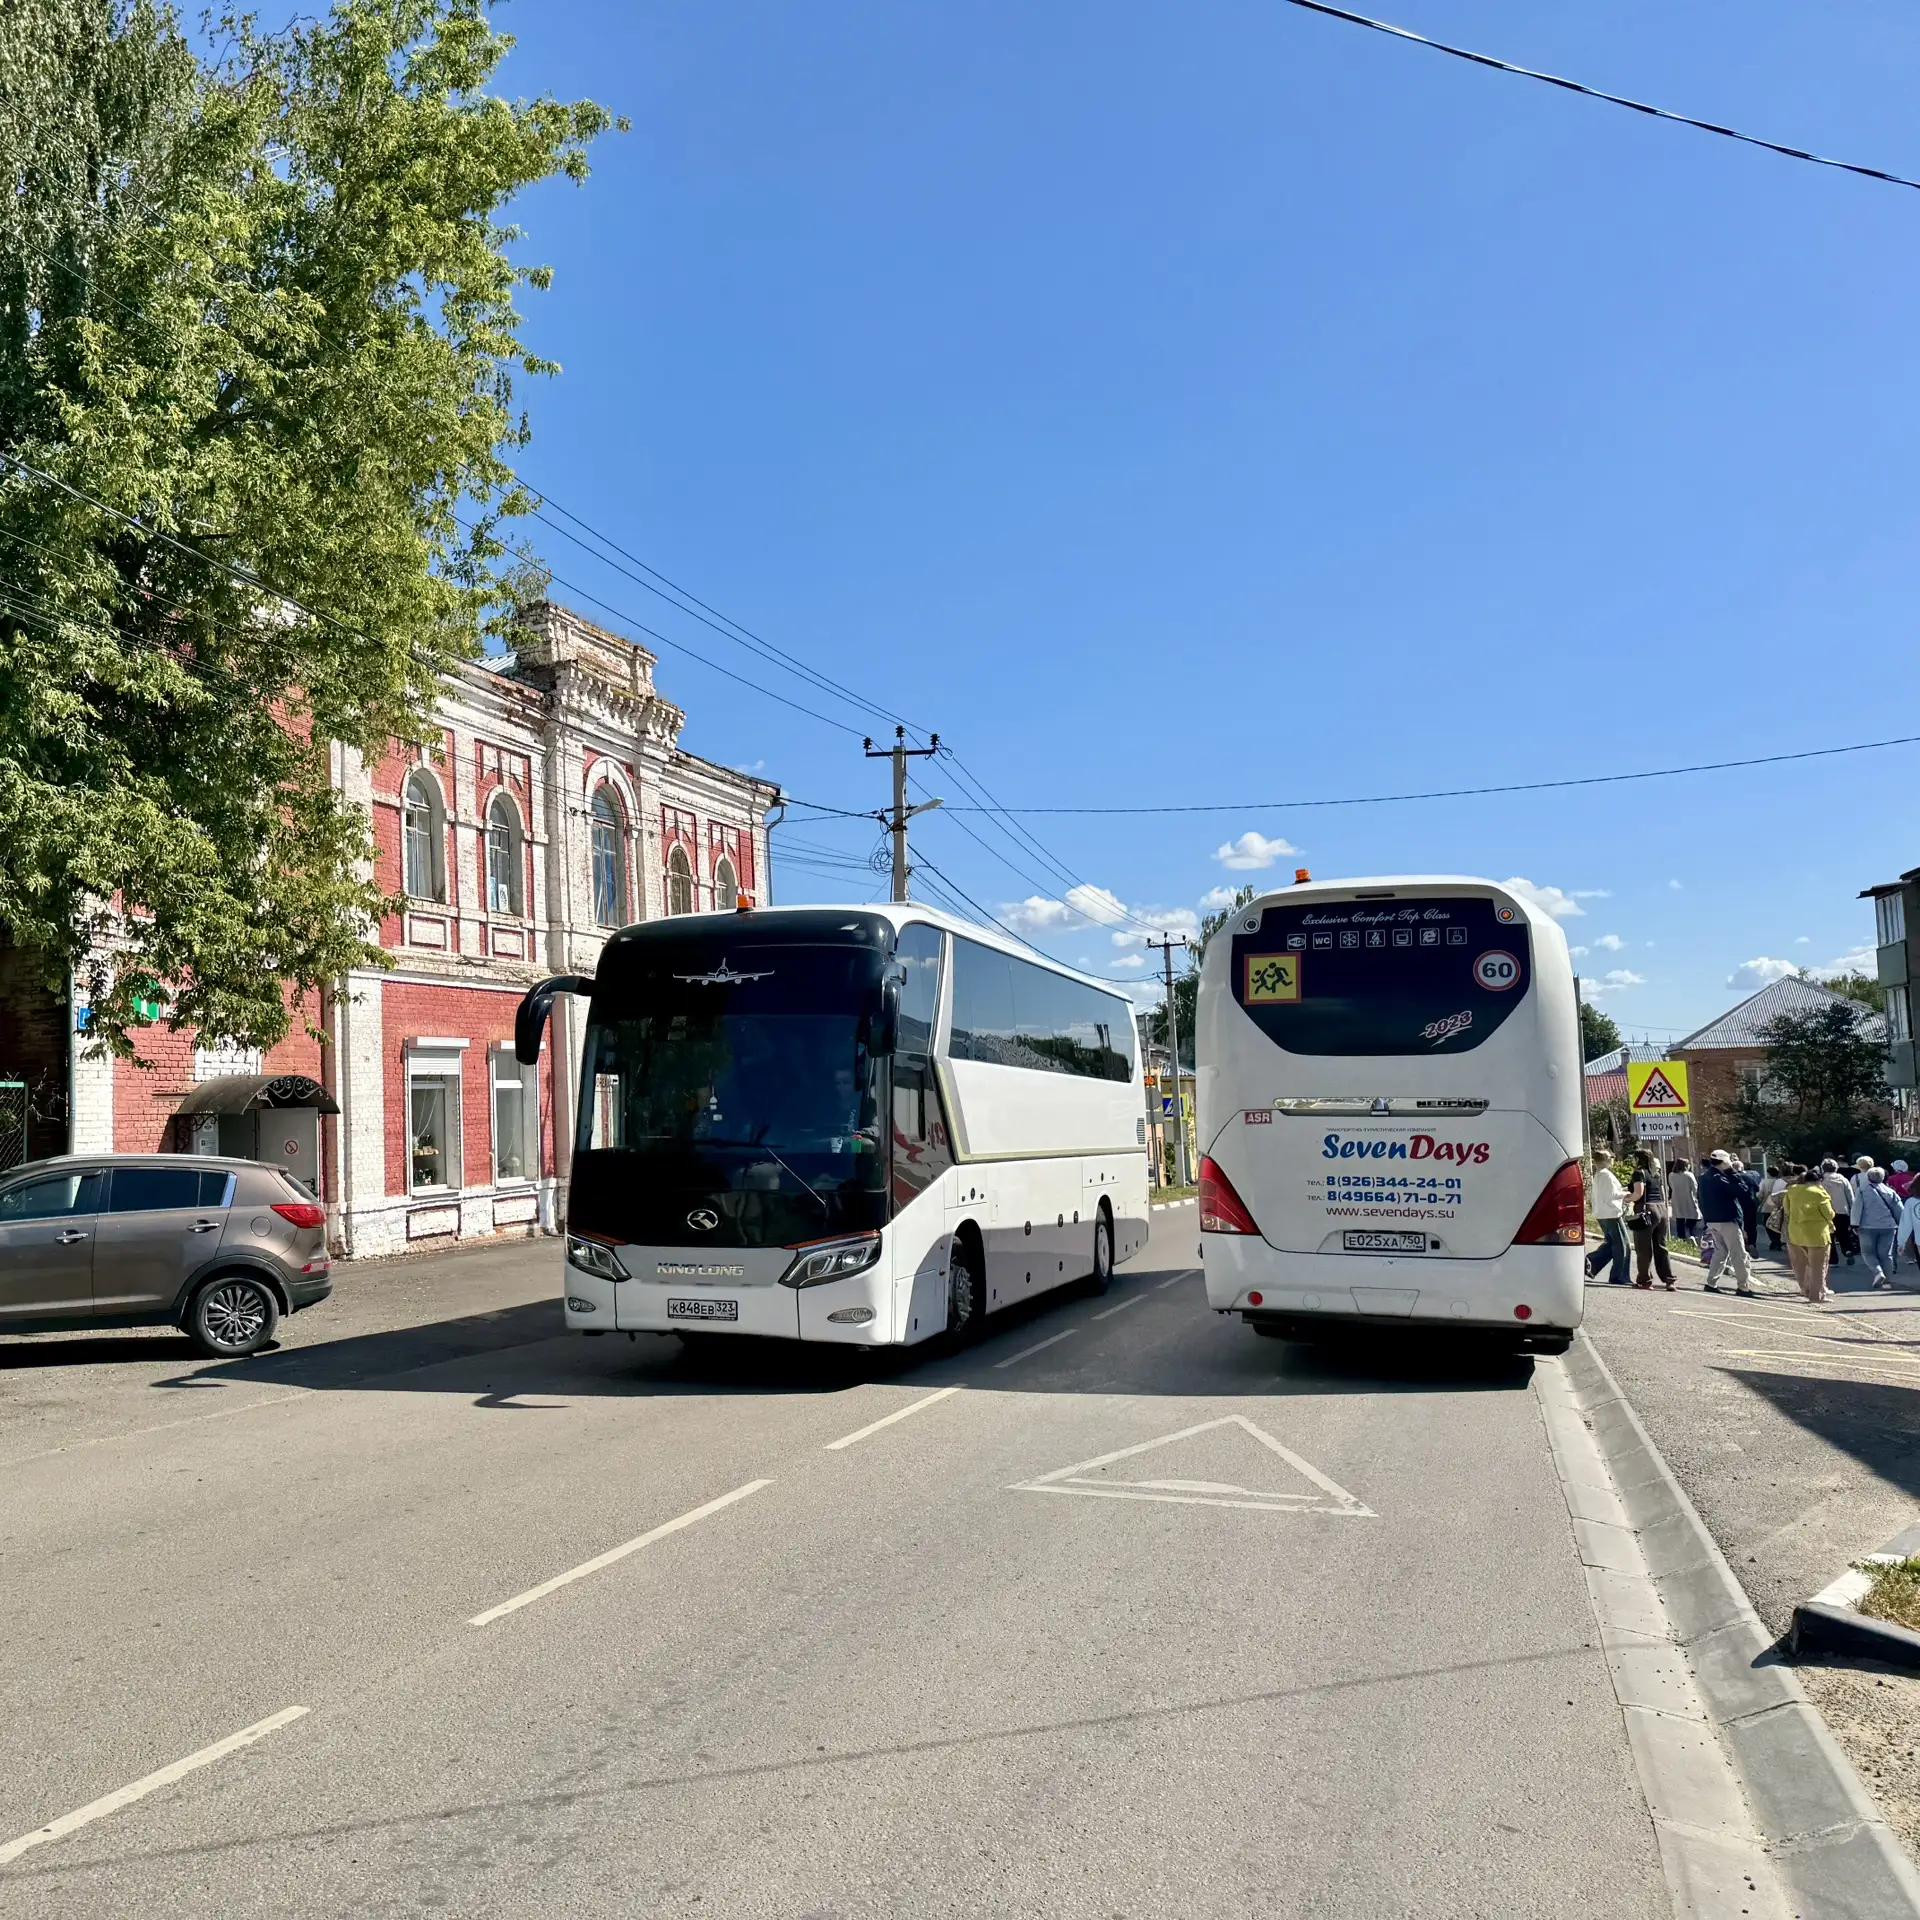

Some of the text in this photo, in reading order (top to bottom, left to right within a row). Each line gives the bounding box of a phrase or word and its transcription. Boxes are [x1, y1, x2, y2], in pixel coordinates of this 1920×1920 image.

[1302, 908, 1451, 925] Exclusive Comfort Top Class
[1315, 937, 1330, 945] WC
[1482, 962, 1512, 979] 60
[1424, 1010, 1473, 1039] 2023
[1247, 1112, 1270, 1123] ASR
[1649, 1123, 1664, 1131] 100
[1326, 1175, 1462, 1189] 8(926)344-24-01
[1326, 1207, 1455, 1220] www.sevendays.su
